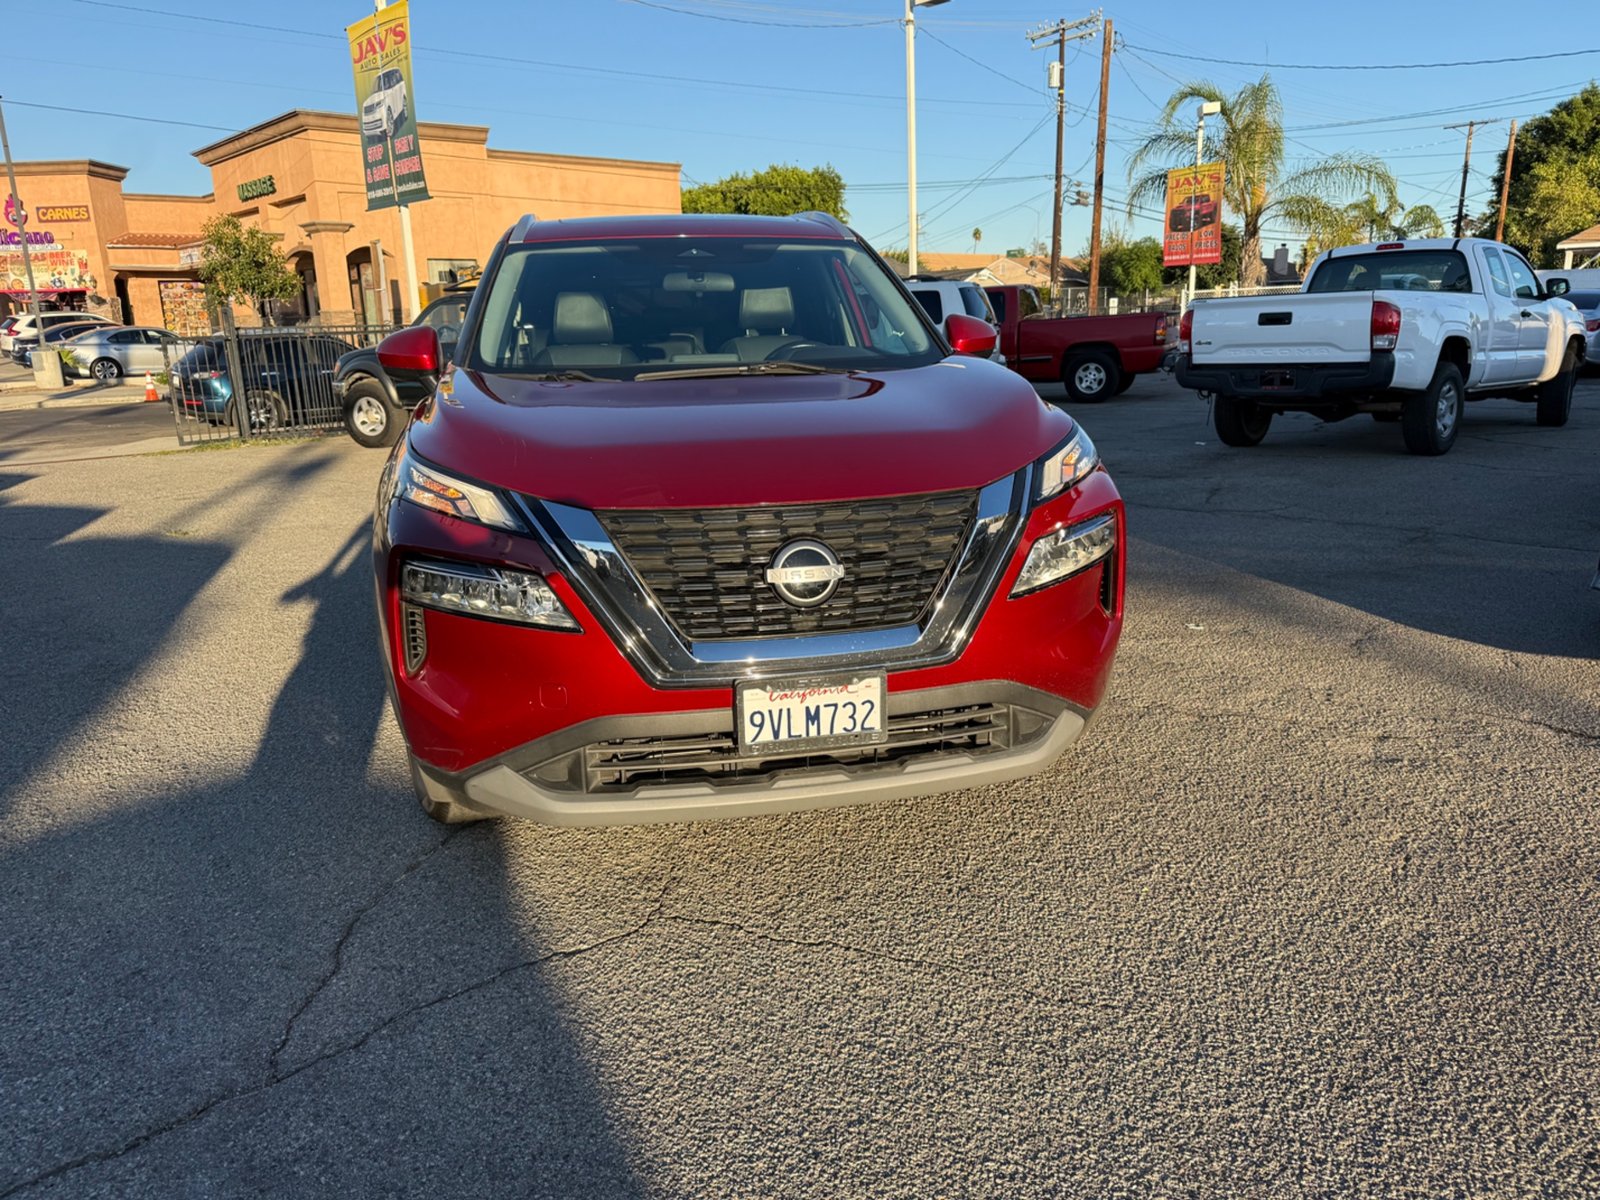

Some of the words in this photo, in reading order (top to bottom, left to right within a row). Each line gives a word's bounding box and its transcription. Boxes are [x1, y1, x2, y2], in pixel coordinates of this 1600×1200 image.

[353, 22, 407, 65] JAV'S
[360, 57, 378, 70] AUTO
[380, 47, 401, 62] SALES
[1169, 172, 1221, 190] JAV'S
[38, 207, 88, 220] CARNES
[49, 251, 72, 259] BEER
[50, 259, 75, 267] WINE
[1226, 346, 1331, 357] TACOMA
[770, 567, 842, 581] NISSAN
[749, 699, 876, 743] 9VLM732
